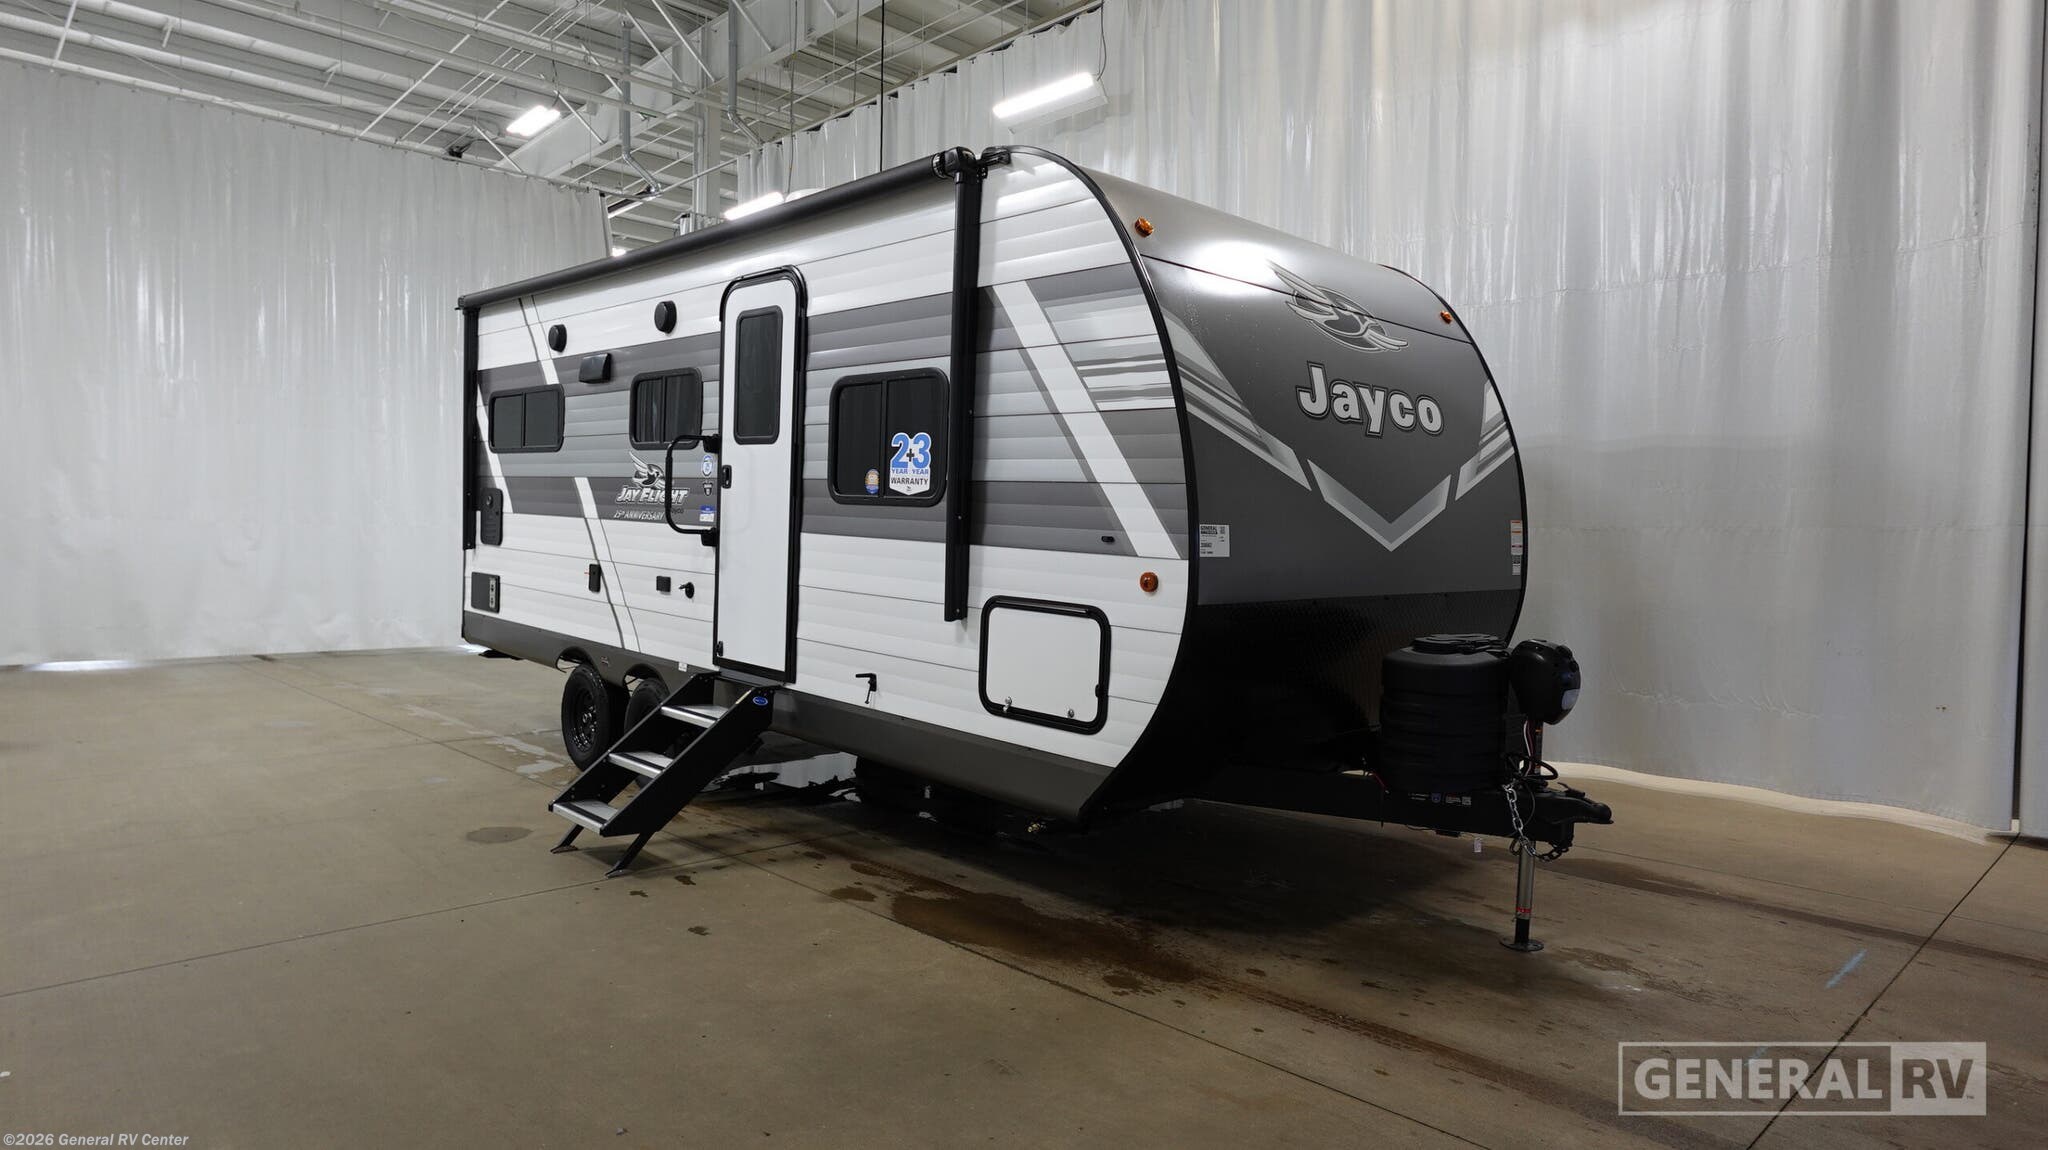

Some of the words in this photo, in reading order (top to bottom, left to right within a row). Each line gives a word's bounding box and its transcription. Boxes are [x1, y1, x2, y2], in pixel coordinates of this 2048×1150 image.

[1296, 362, 1444, 438] Jayco
[891, 477, 929, 485] WARRANTY
[616, 485, 641, 504] JAY
